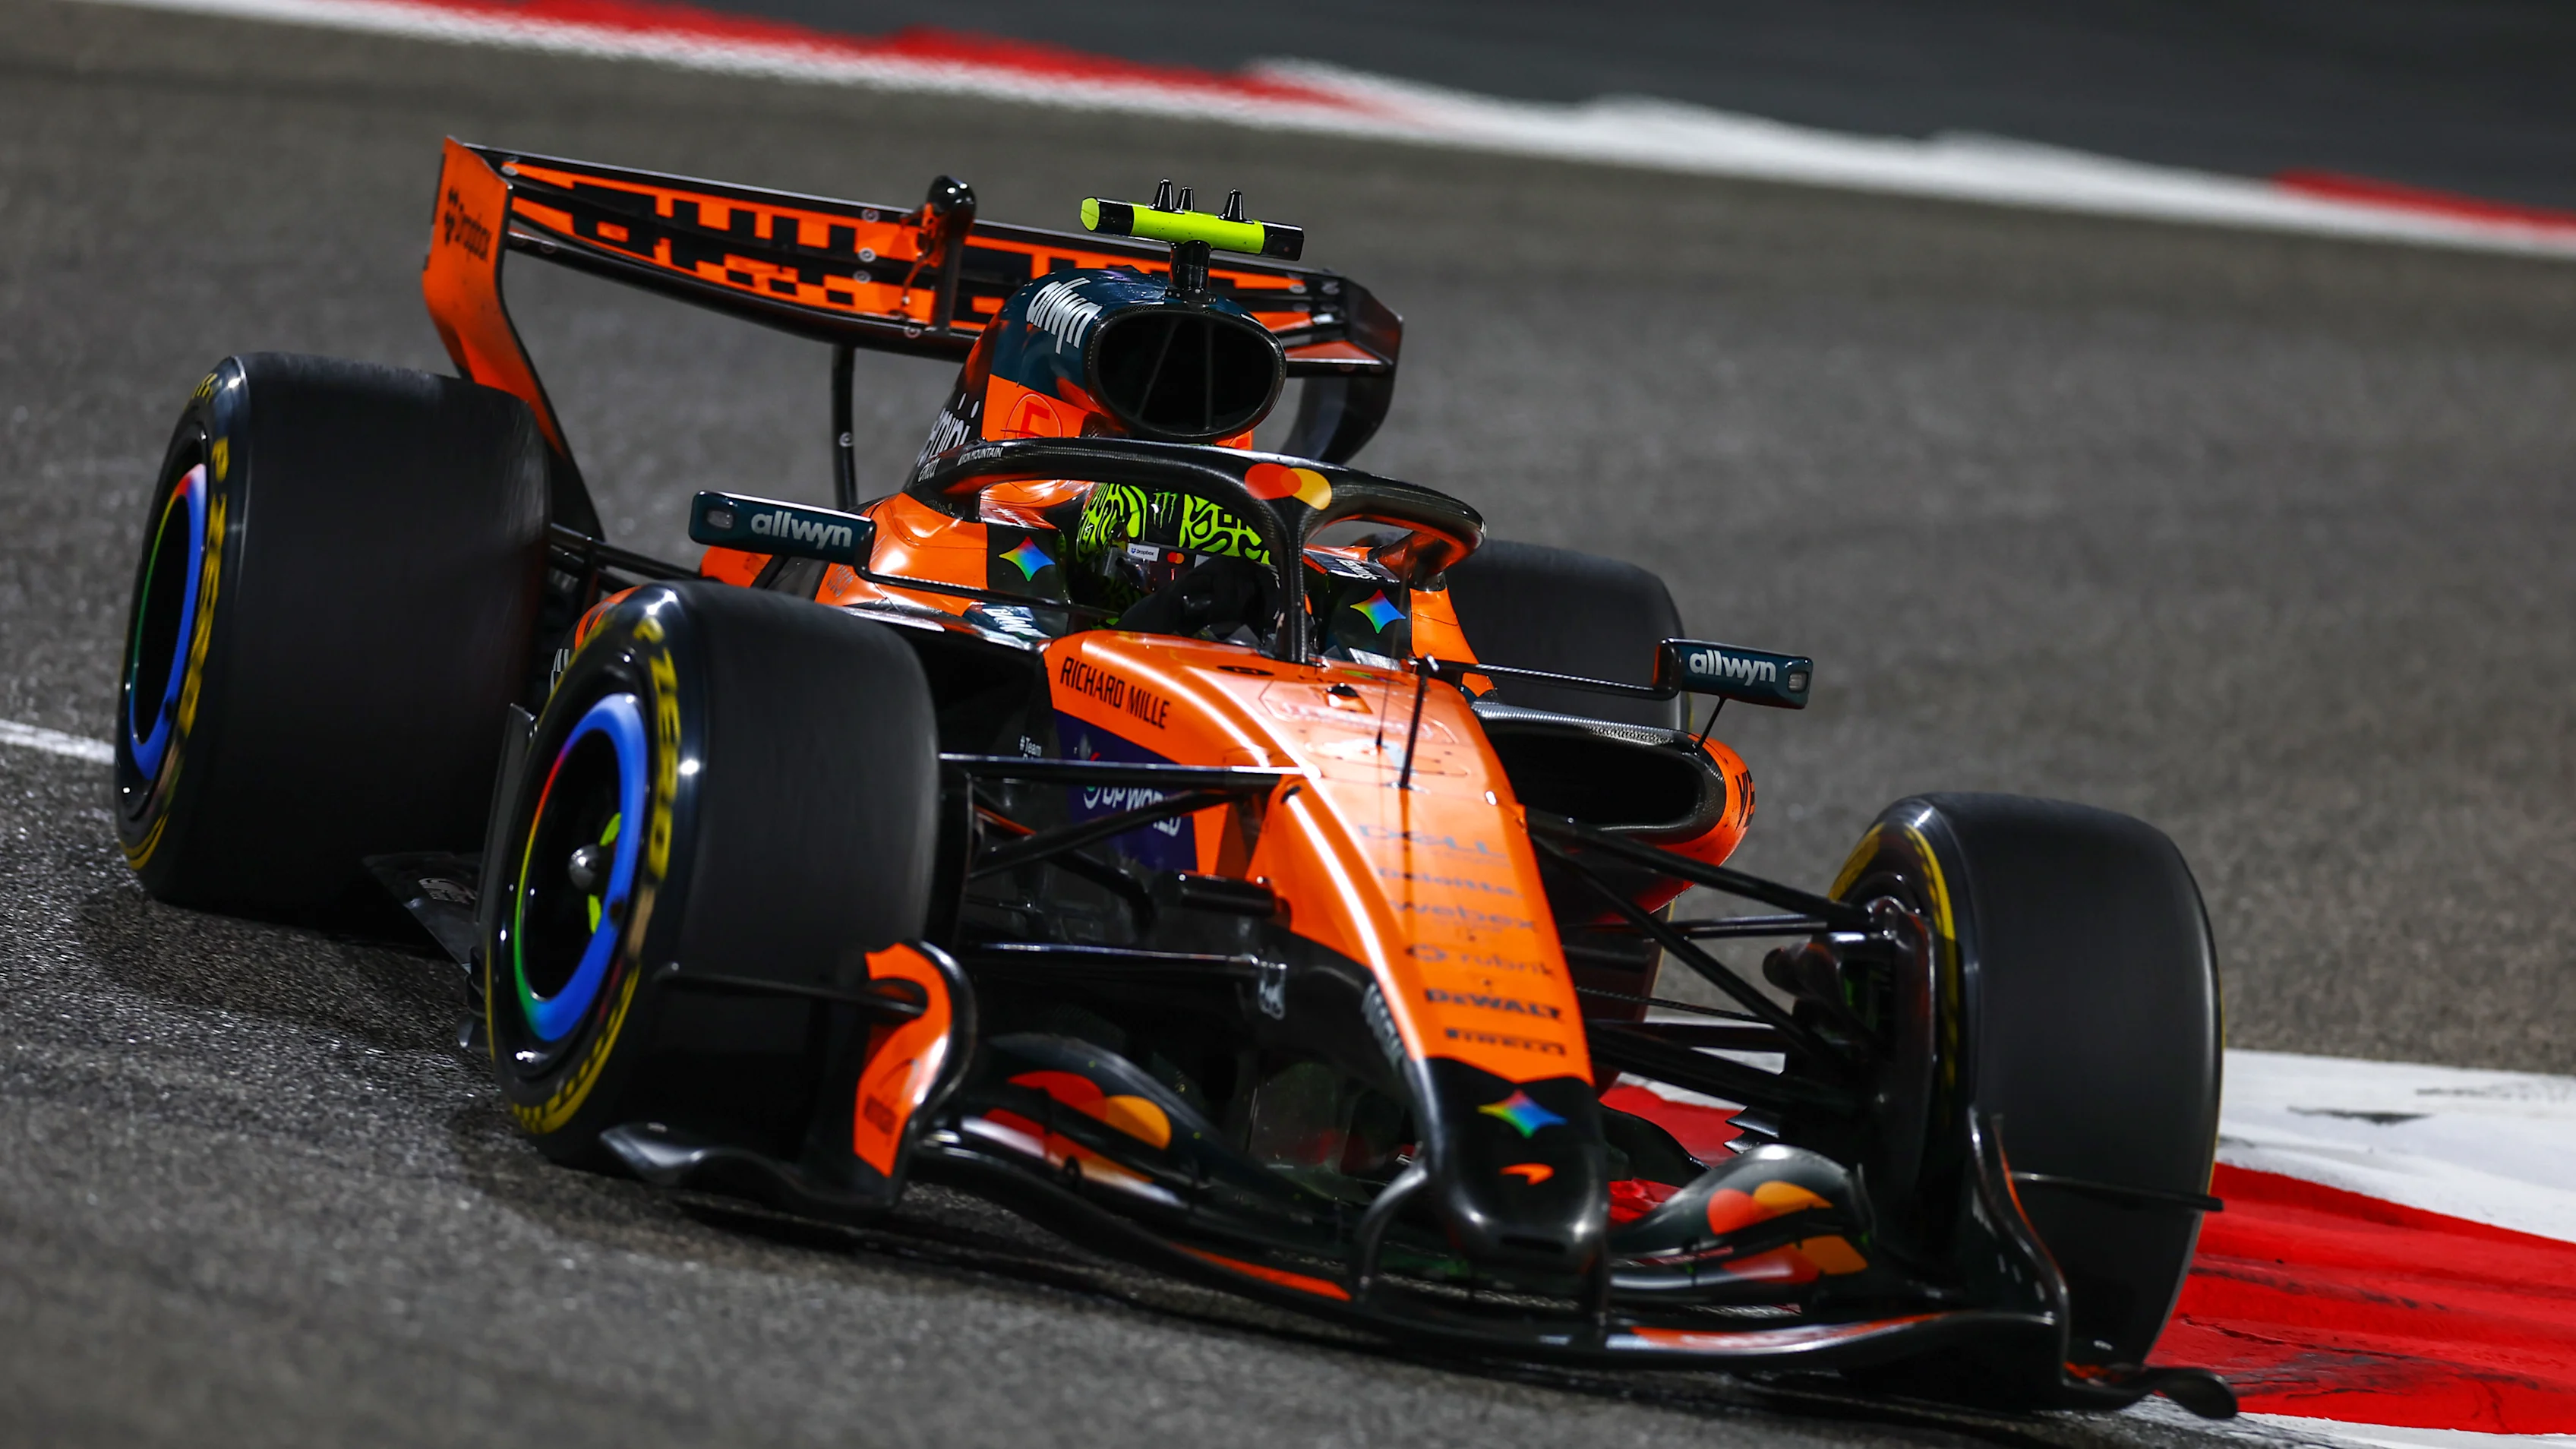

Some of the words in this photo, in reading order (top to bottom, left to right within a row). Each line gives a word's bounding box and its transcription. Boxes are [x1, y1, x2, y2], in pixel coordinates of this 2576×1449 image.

[1025, 277, 1103, 355] allwyn
[971, 447, 1004, 462] MOUNTAIN
[750, 510, 853, 551] allwyn
[1689, 649, 1776, 687] allwyn
[1060, 655, 1125, 709] RICHARD
[1126, 685, 1171, 730] MILLE
